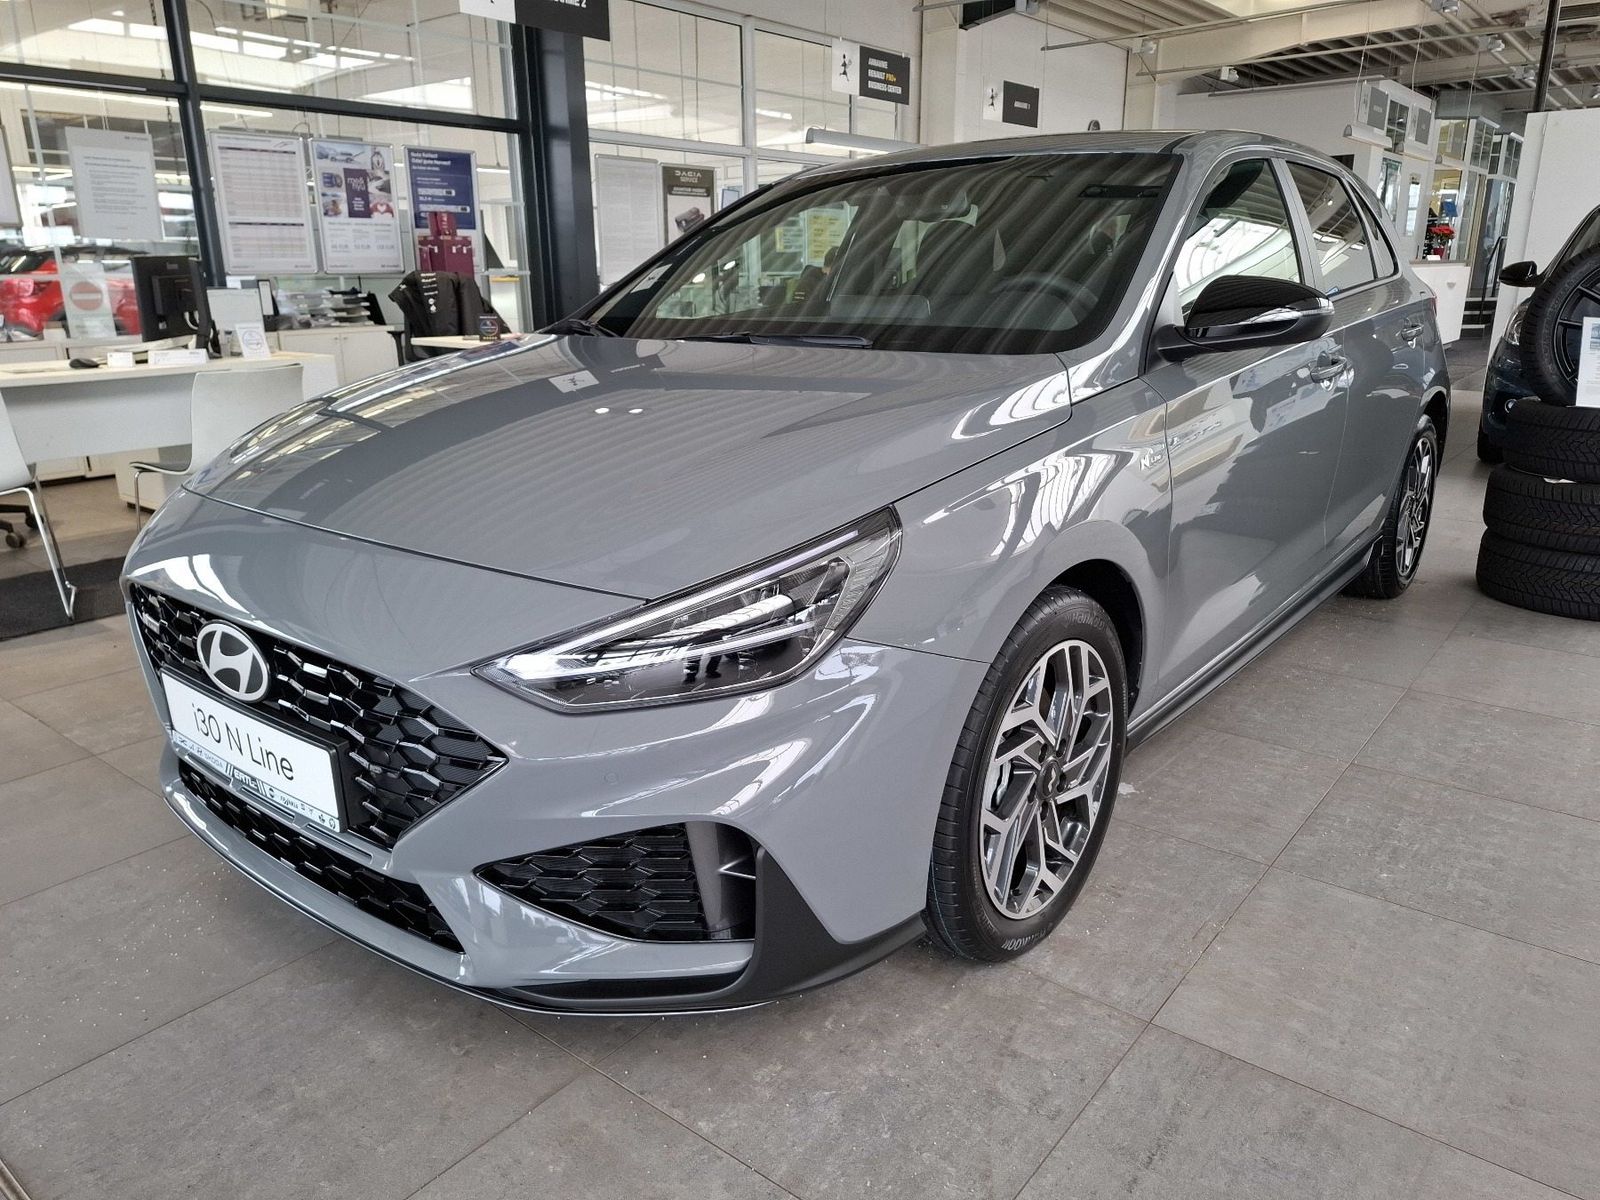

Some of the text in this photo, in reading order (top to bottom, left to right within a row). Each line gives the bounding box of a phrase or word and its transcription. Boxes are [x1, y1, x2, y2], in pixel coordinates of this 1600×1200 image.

[192, 703, 221, 743] i30
[225, 722, 244, 756] N
[247, 733, 294, 781] Line
